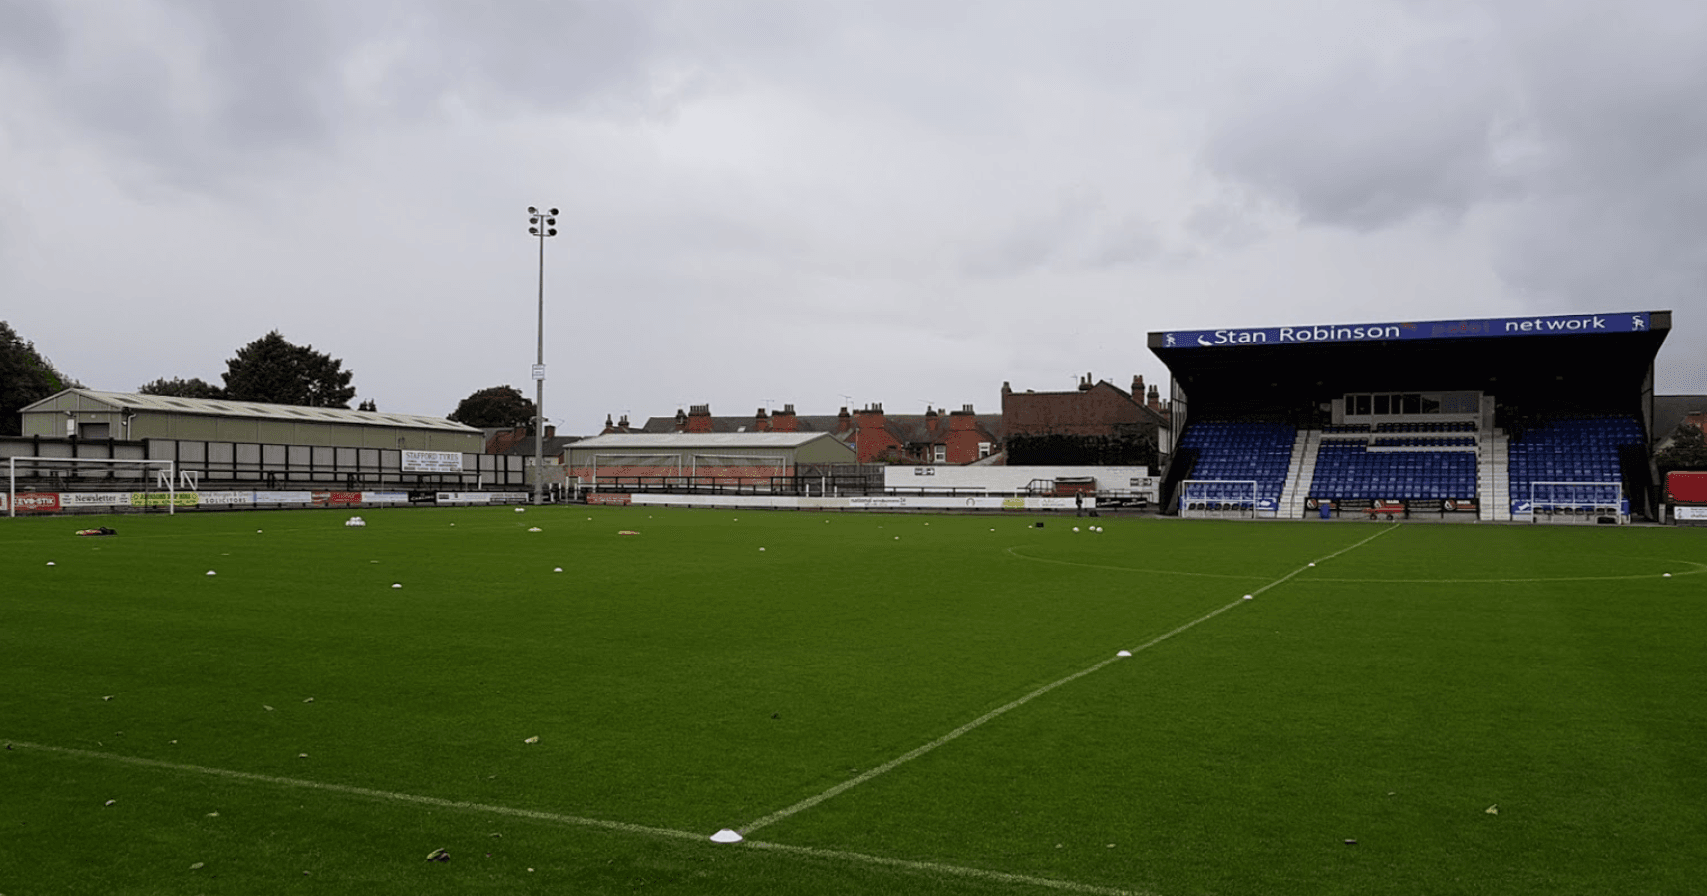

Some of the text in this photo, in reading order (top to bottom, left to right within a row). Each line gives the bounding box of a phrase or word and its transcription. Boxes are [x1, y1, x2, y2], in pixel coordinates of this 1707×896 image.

[1214, 329, 1266, 344] Stan
[1279, 325, 1400, 341] Robinson
[1505, 316, 1606, 331] network
[405, 452, 459, 461] STAFFORD TYRES
[75, 493, 116, 502] Newsletter
